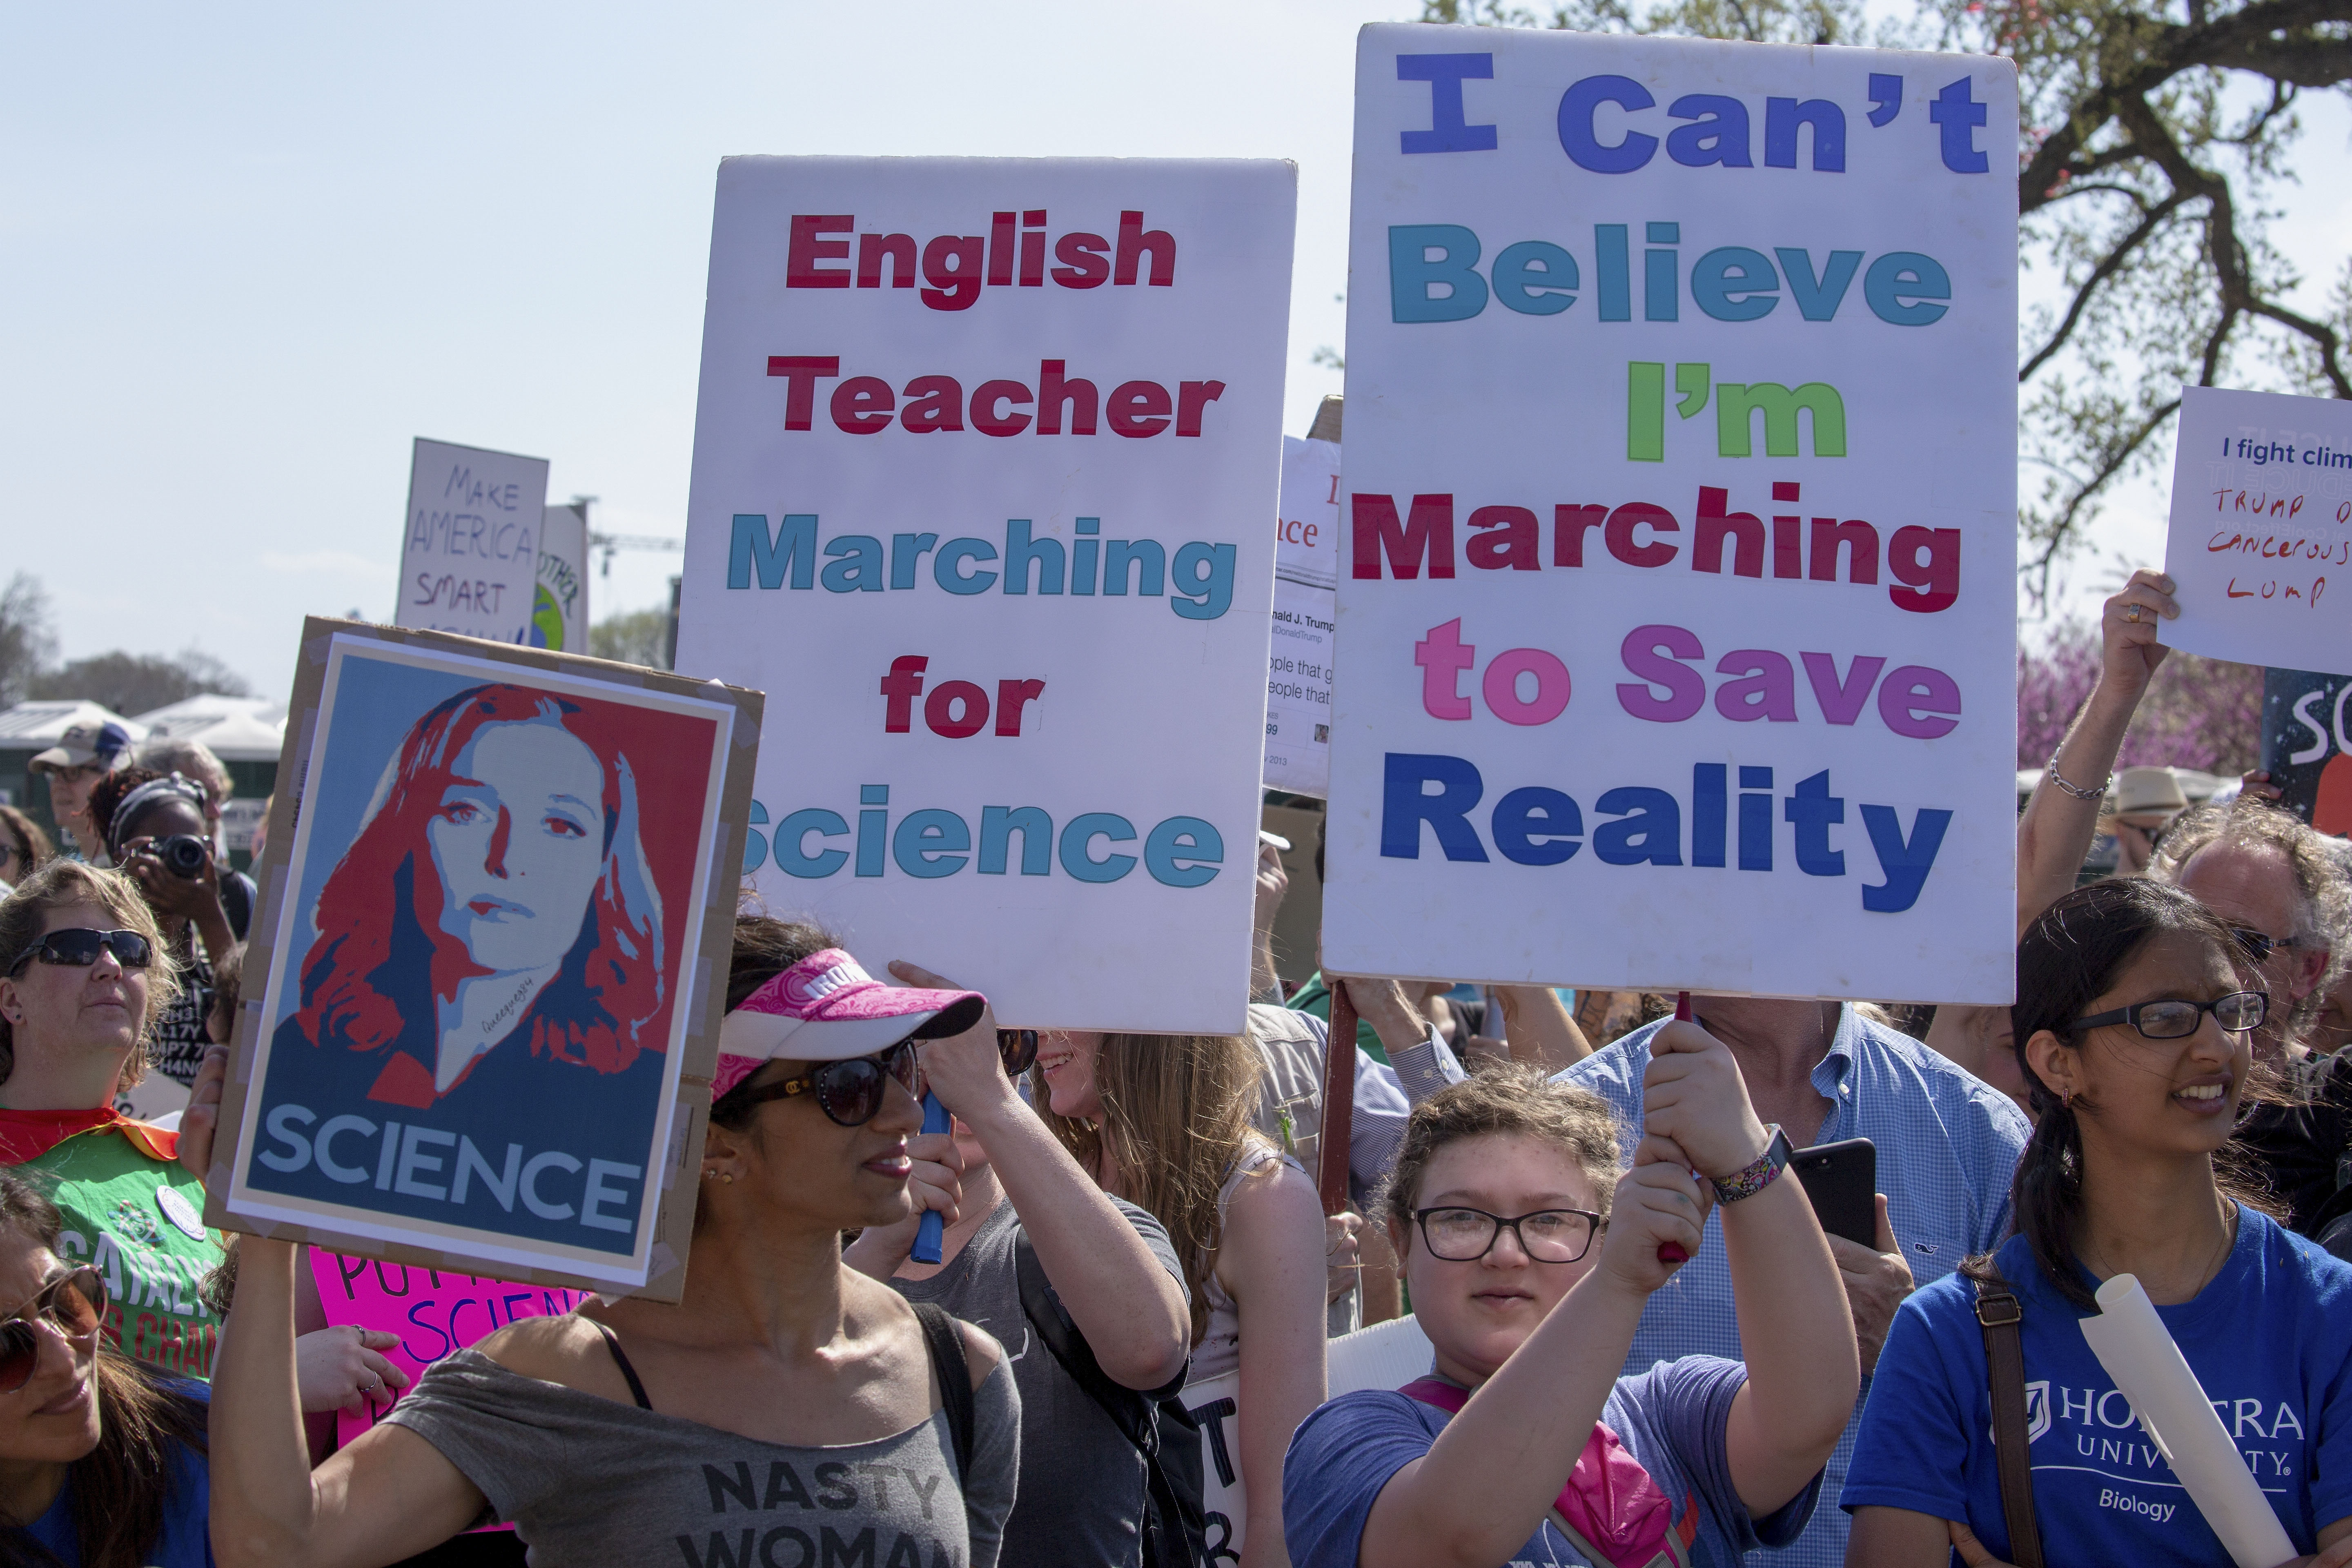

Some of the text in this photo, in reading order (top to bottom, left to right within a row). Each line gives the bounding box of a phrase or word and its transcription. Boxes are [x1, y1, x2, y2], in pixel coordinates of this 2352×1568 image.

[1396, 52, 1989, 174] I Can't
[786, 209, 1177, 311] English
[1388, 221, 1952, 326] Believe
[766, 356, 1226, 439] Teacher
[1627, 361, 1847, 463] I'm
[2223, 437, 2229, 457] I
[2238, 439, 2295, 465] fight
[445, 465, 519, 511] MAKE
[410, 509, 533, 566] AMERICA
[1352, 481, 1962, 612] Marching
[414, 573, 507, 615] SMART
[726, 514, 1236, 620] Marching
[1294, 614, 1302, 625] J.
[1305, 616, 1334, 633] Trump
[881, 654, 1046, 738] for
[1298, 660, 1321, 679] that
[1306, 686, 1330, 704] that
[1414, 616, 1962, 740] to Save
[1269, 755, 1287, 766] 2013
[1380, 752, 1954, 913] Reality
[257, 1104, 641, 1234] SCIENCE
[2060, 1386, 2305, 1441] HORA
[2078, 1434, 2290, 1476] UNIVTY
[701, 1461, 940, 1520] NASTY
[2100, 1489, 2175, 1523] Biology
[676, 1526, 962, 1568] WOMAN
